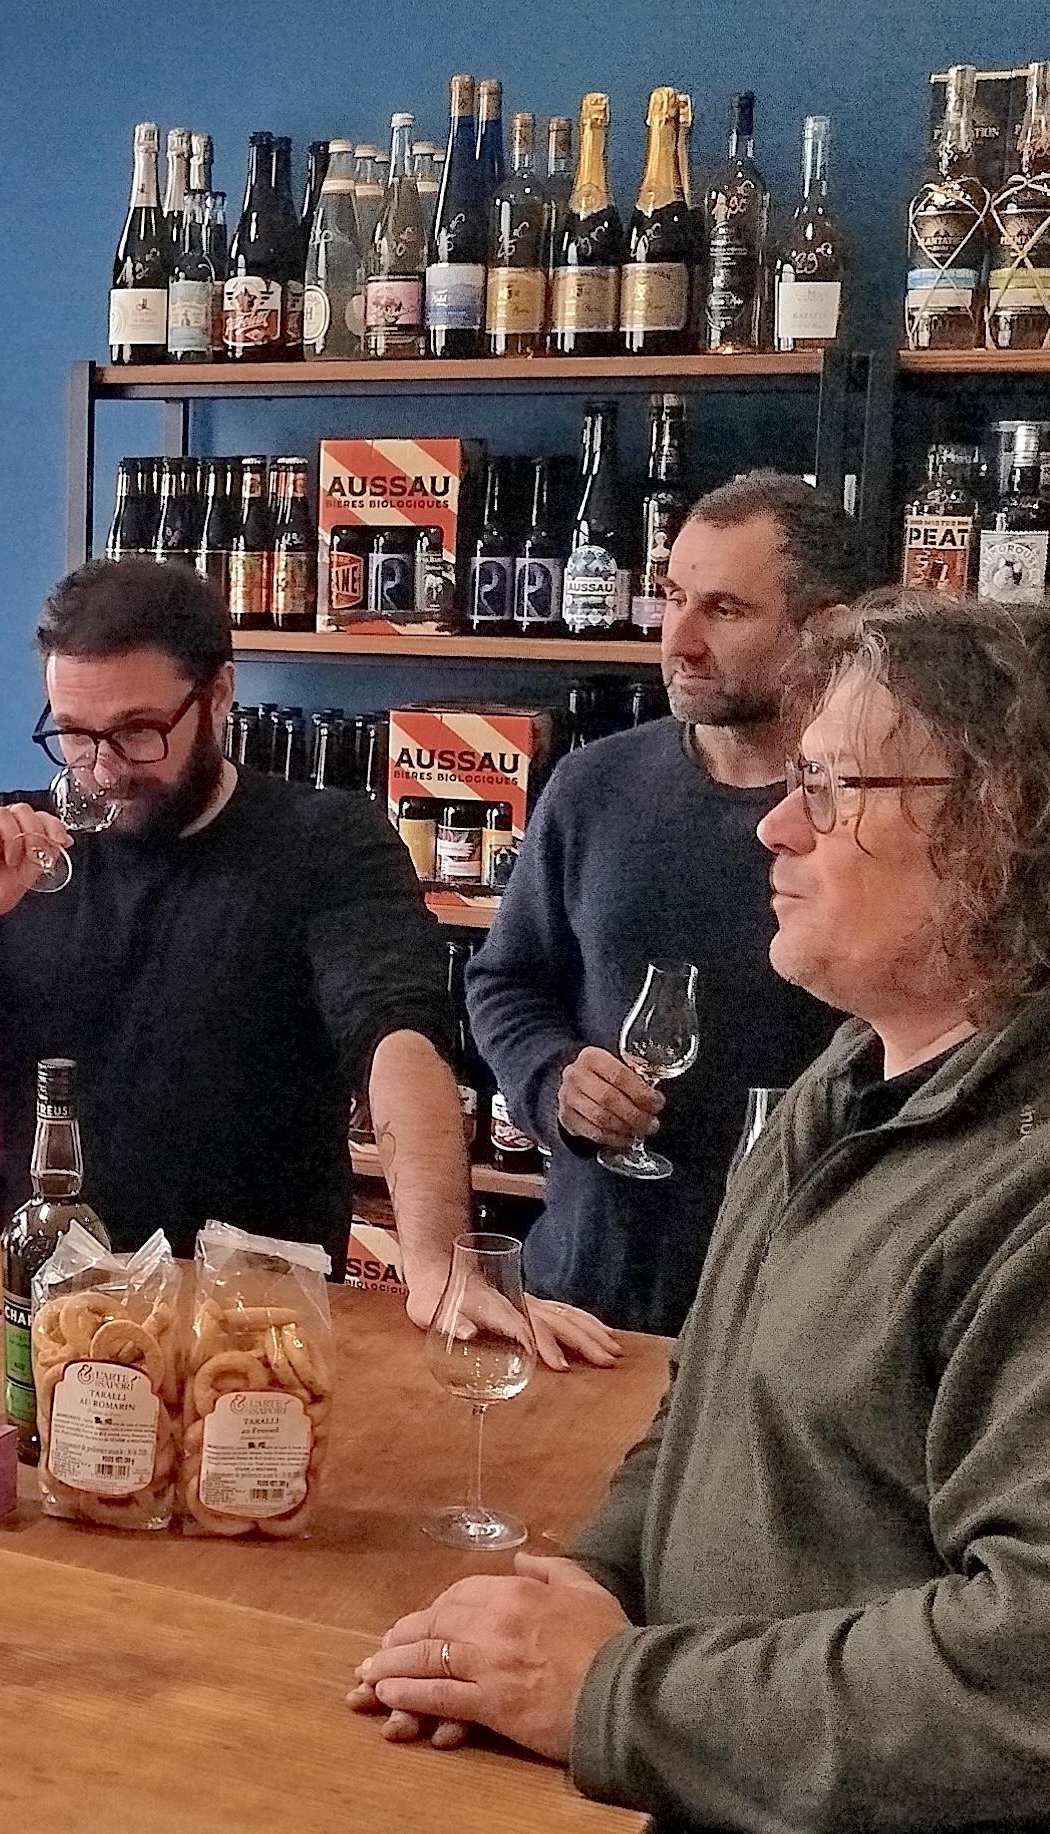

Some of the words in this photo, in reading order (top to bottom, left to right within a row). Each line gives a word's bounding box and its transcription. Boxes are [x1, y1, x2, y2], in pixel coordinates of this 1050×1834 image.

[326, 476, 451, 497] AUSSAU
[368, 500, 449, 509] BIOLOGIQUES
[909, 528, 970, 547] PEAT
[569, 583, 613, 592] AUSSAU
[395, 748, 520, 774] AUSSAU
[437, 773, 519, 786] BIOLOGIQUES
[93, 1400, 136, 1411] ROMARIN
